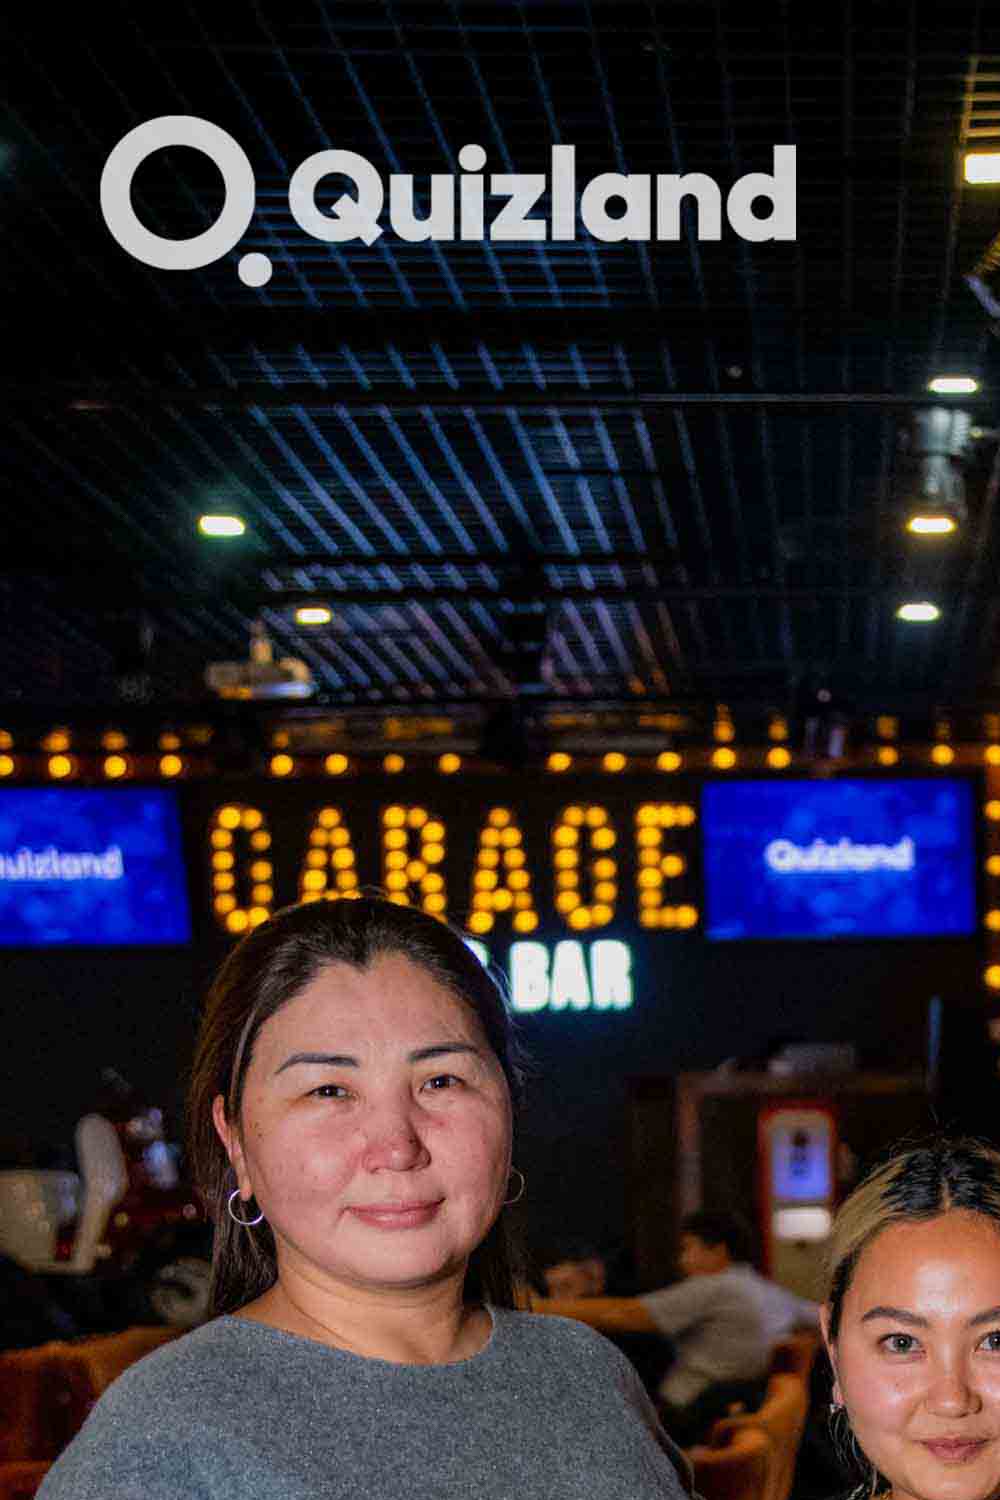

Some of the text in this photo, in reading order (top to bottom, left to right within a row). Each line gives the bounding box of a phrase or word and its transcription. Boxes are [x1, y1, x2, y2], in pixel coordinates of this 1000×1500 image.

[211, 802, 699, 935] GARAGE
[763, 835, 915, 874] Quizland
[508, 938, 635, 1013] BAR
